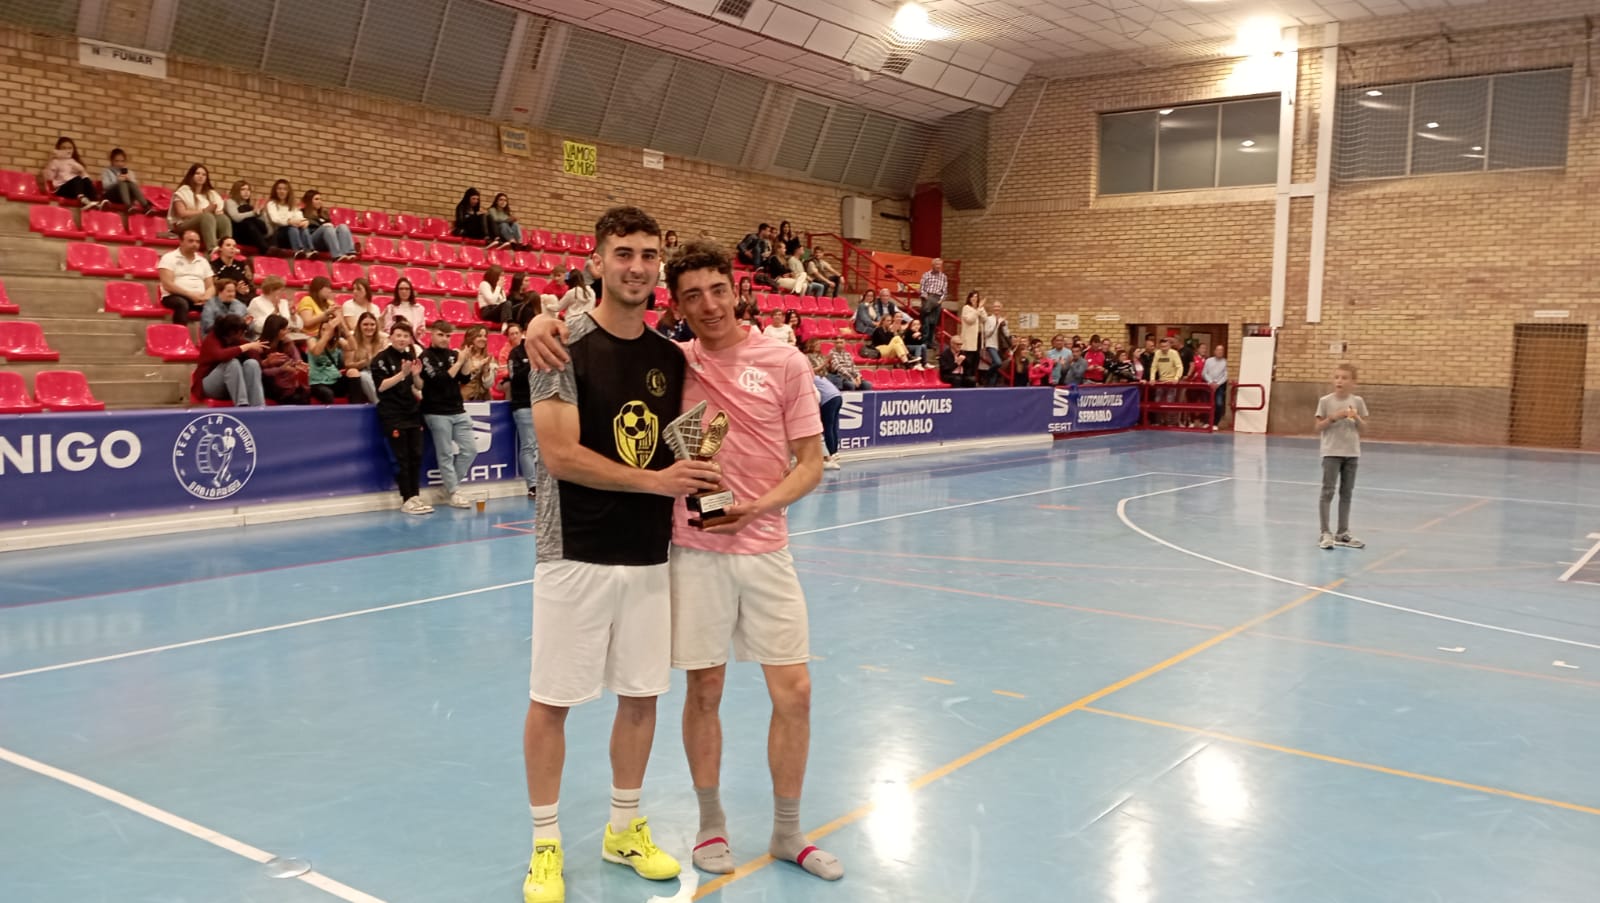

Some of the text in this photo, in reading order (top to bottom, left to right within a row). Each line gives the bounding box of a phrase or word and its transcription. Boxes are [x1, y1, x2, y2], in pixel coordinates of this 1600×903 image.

[564, 143, 595, 163] VAMOS
[880, 395, 952, 416] AUTOMÓVILES
[1077, 392, 1123, 407] AUTOMÓVILES
[207, 415, 224, 425] LA
[1078, 409, 1112, 423] SERRABLO
[880, 418, 933, 437] SERRABLO
[1048, 422, 1072, 432] SEAT
[838, 436, 870, 449] EAT
[426, 463, 508, 485] SAT
